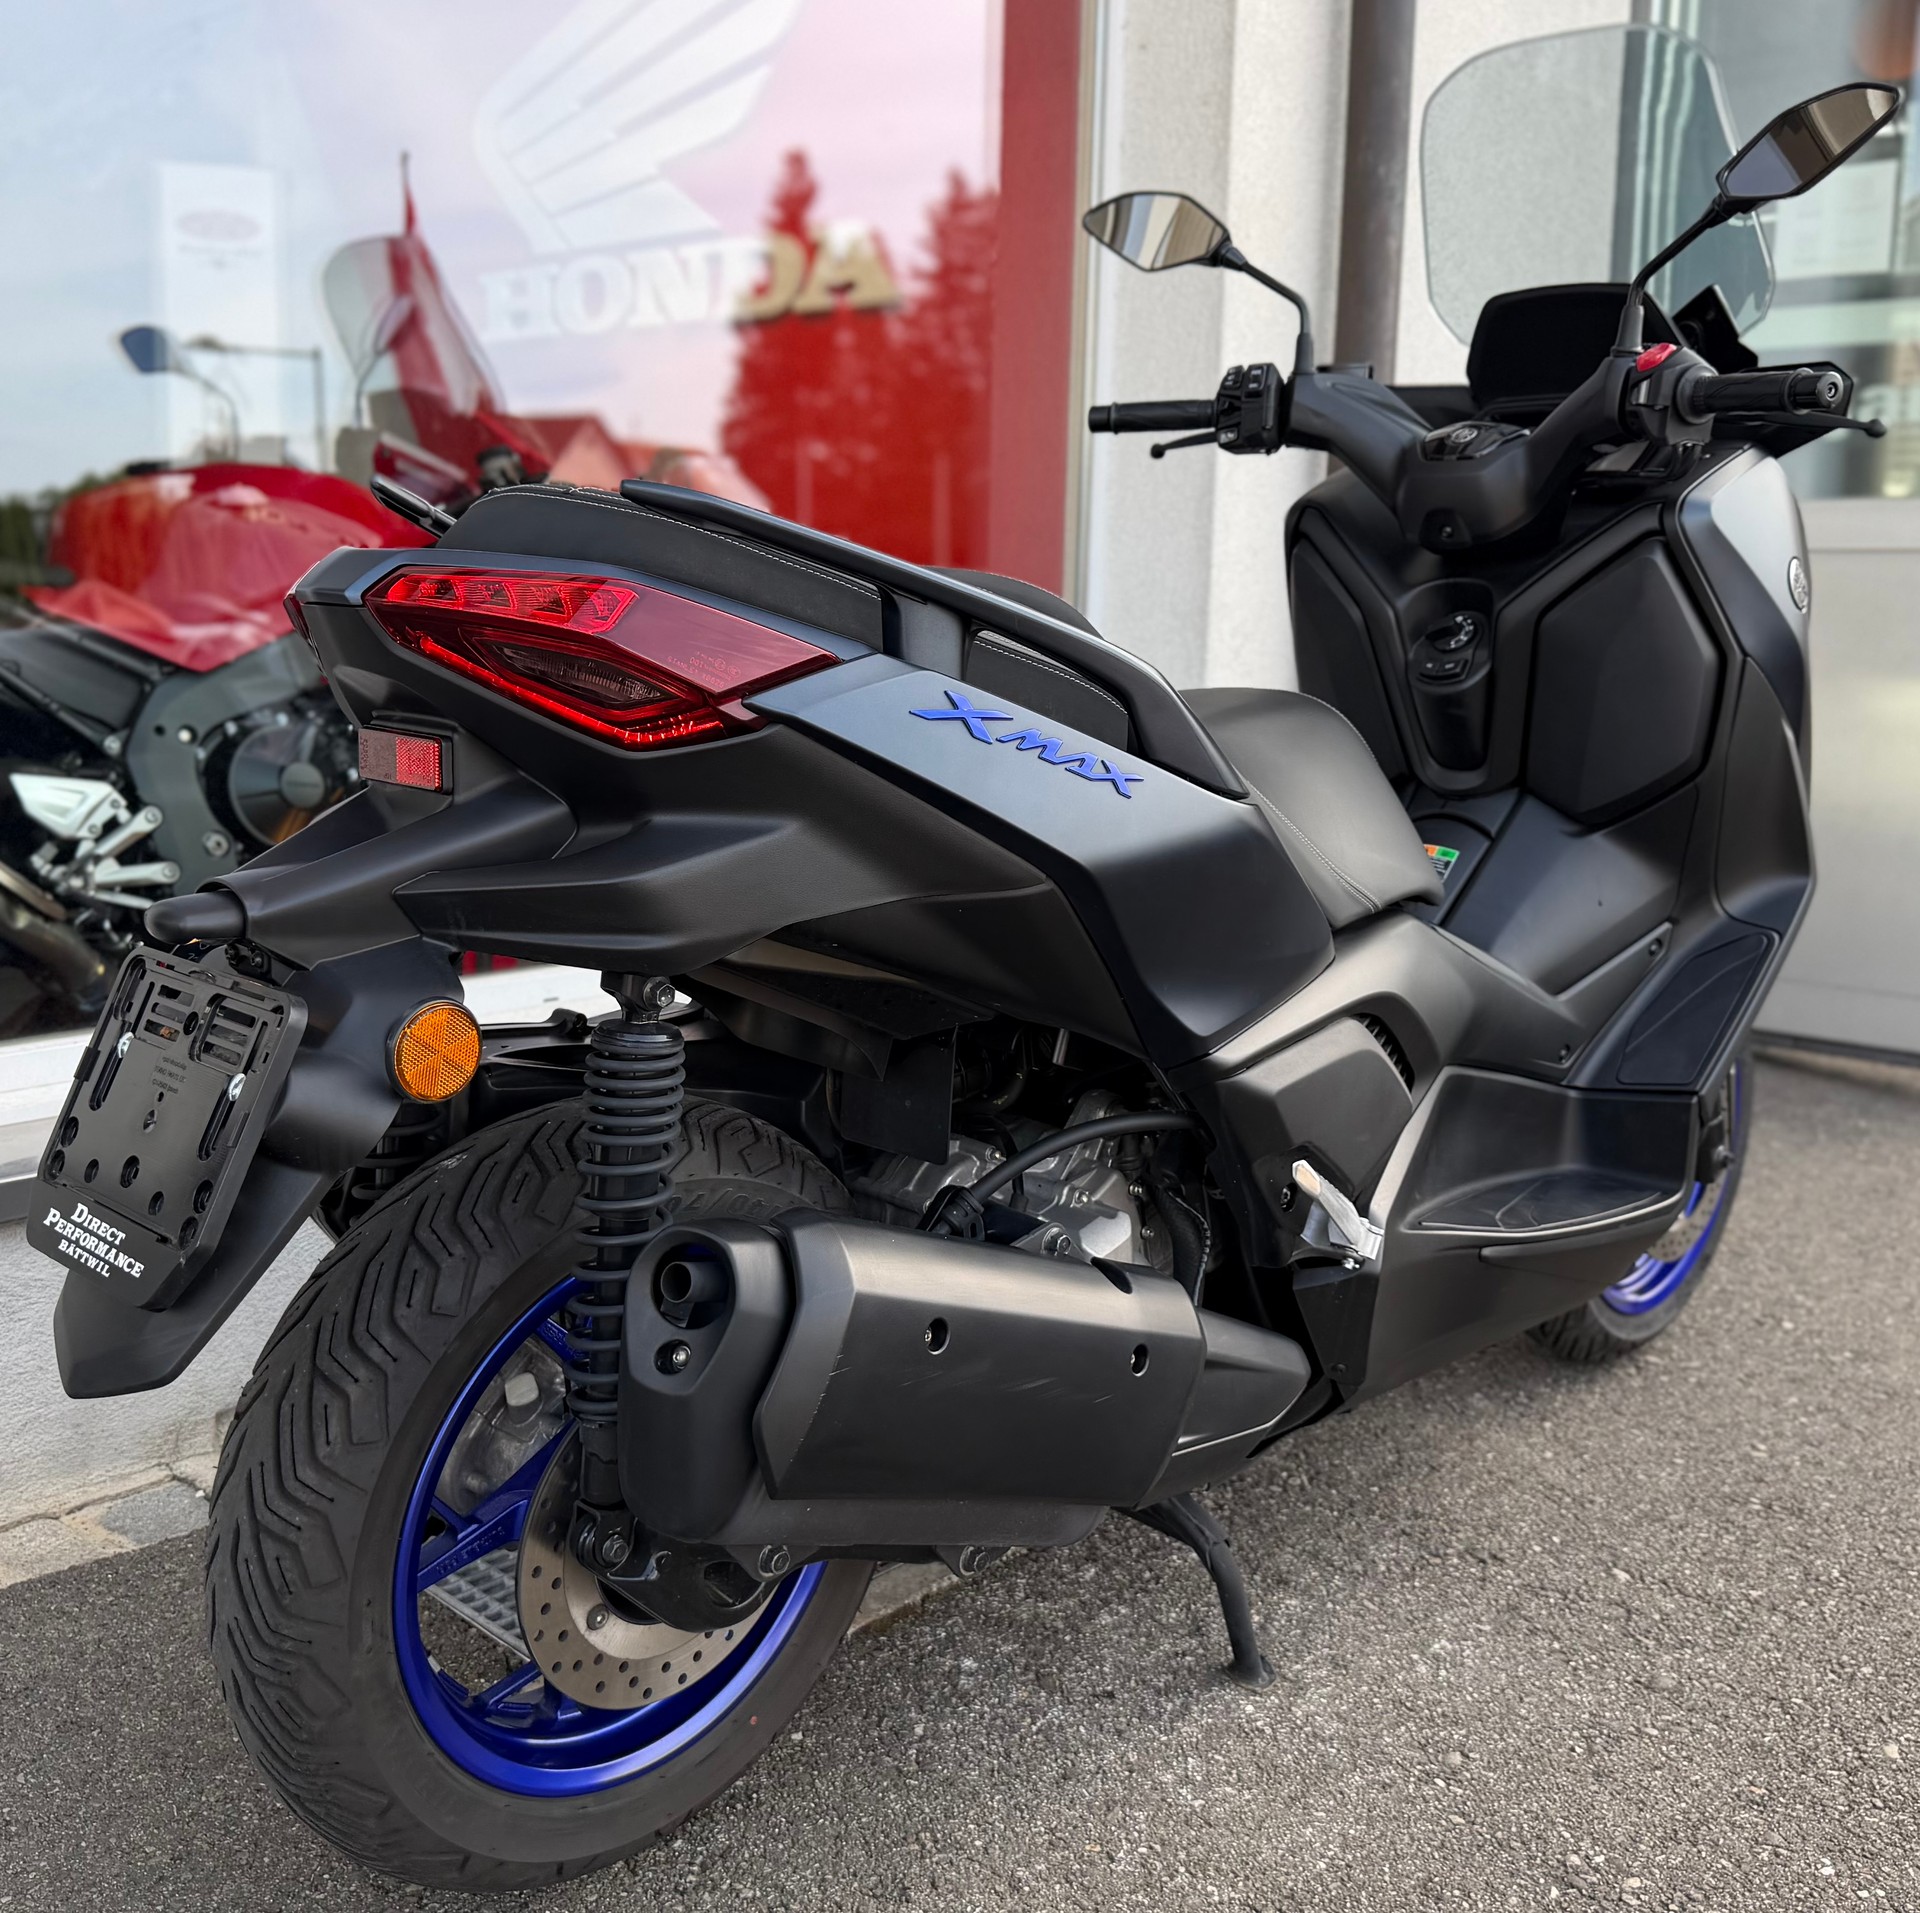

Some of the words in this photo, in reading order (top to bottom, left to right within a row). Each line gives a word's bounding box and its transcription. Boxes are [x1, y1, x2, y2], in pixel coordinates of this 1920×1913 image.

[480, 222, 899, 342] HONDA
[43, 1207, 145, 1278] PERFORMANCE
[70, 1202, 126, 1246] DIRECT
[58, 1239, 111, 1278] BÄTTWIL
